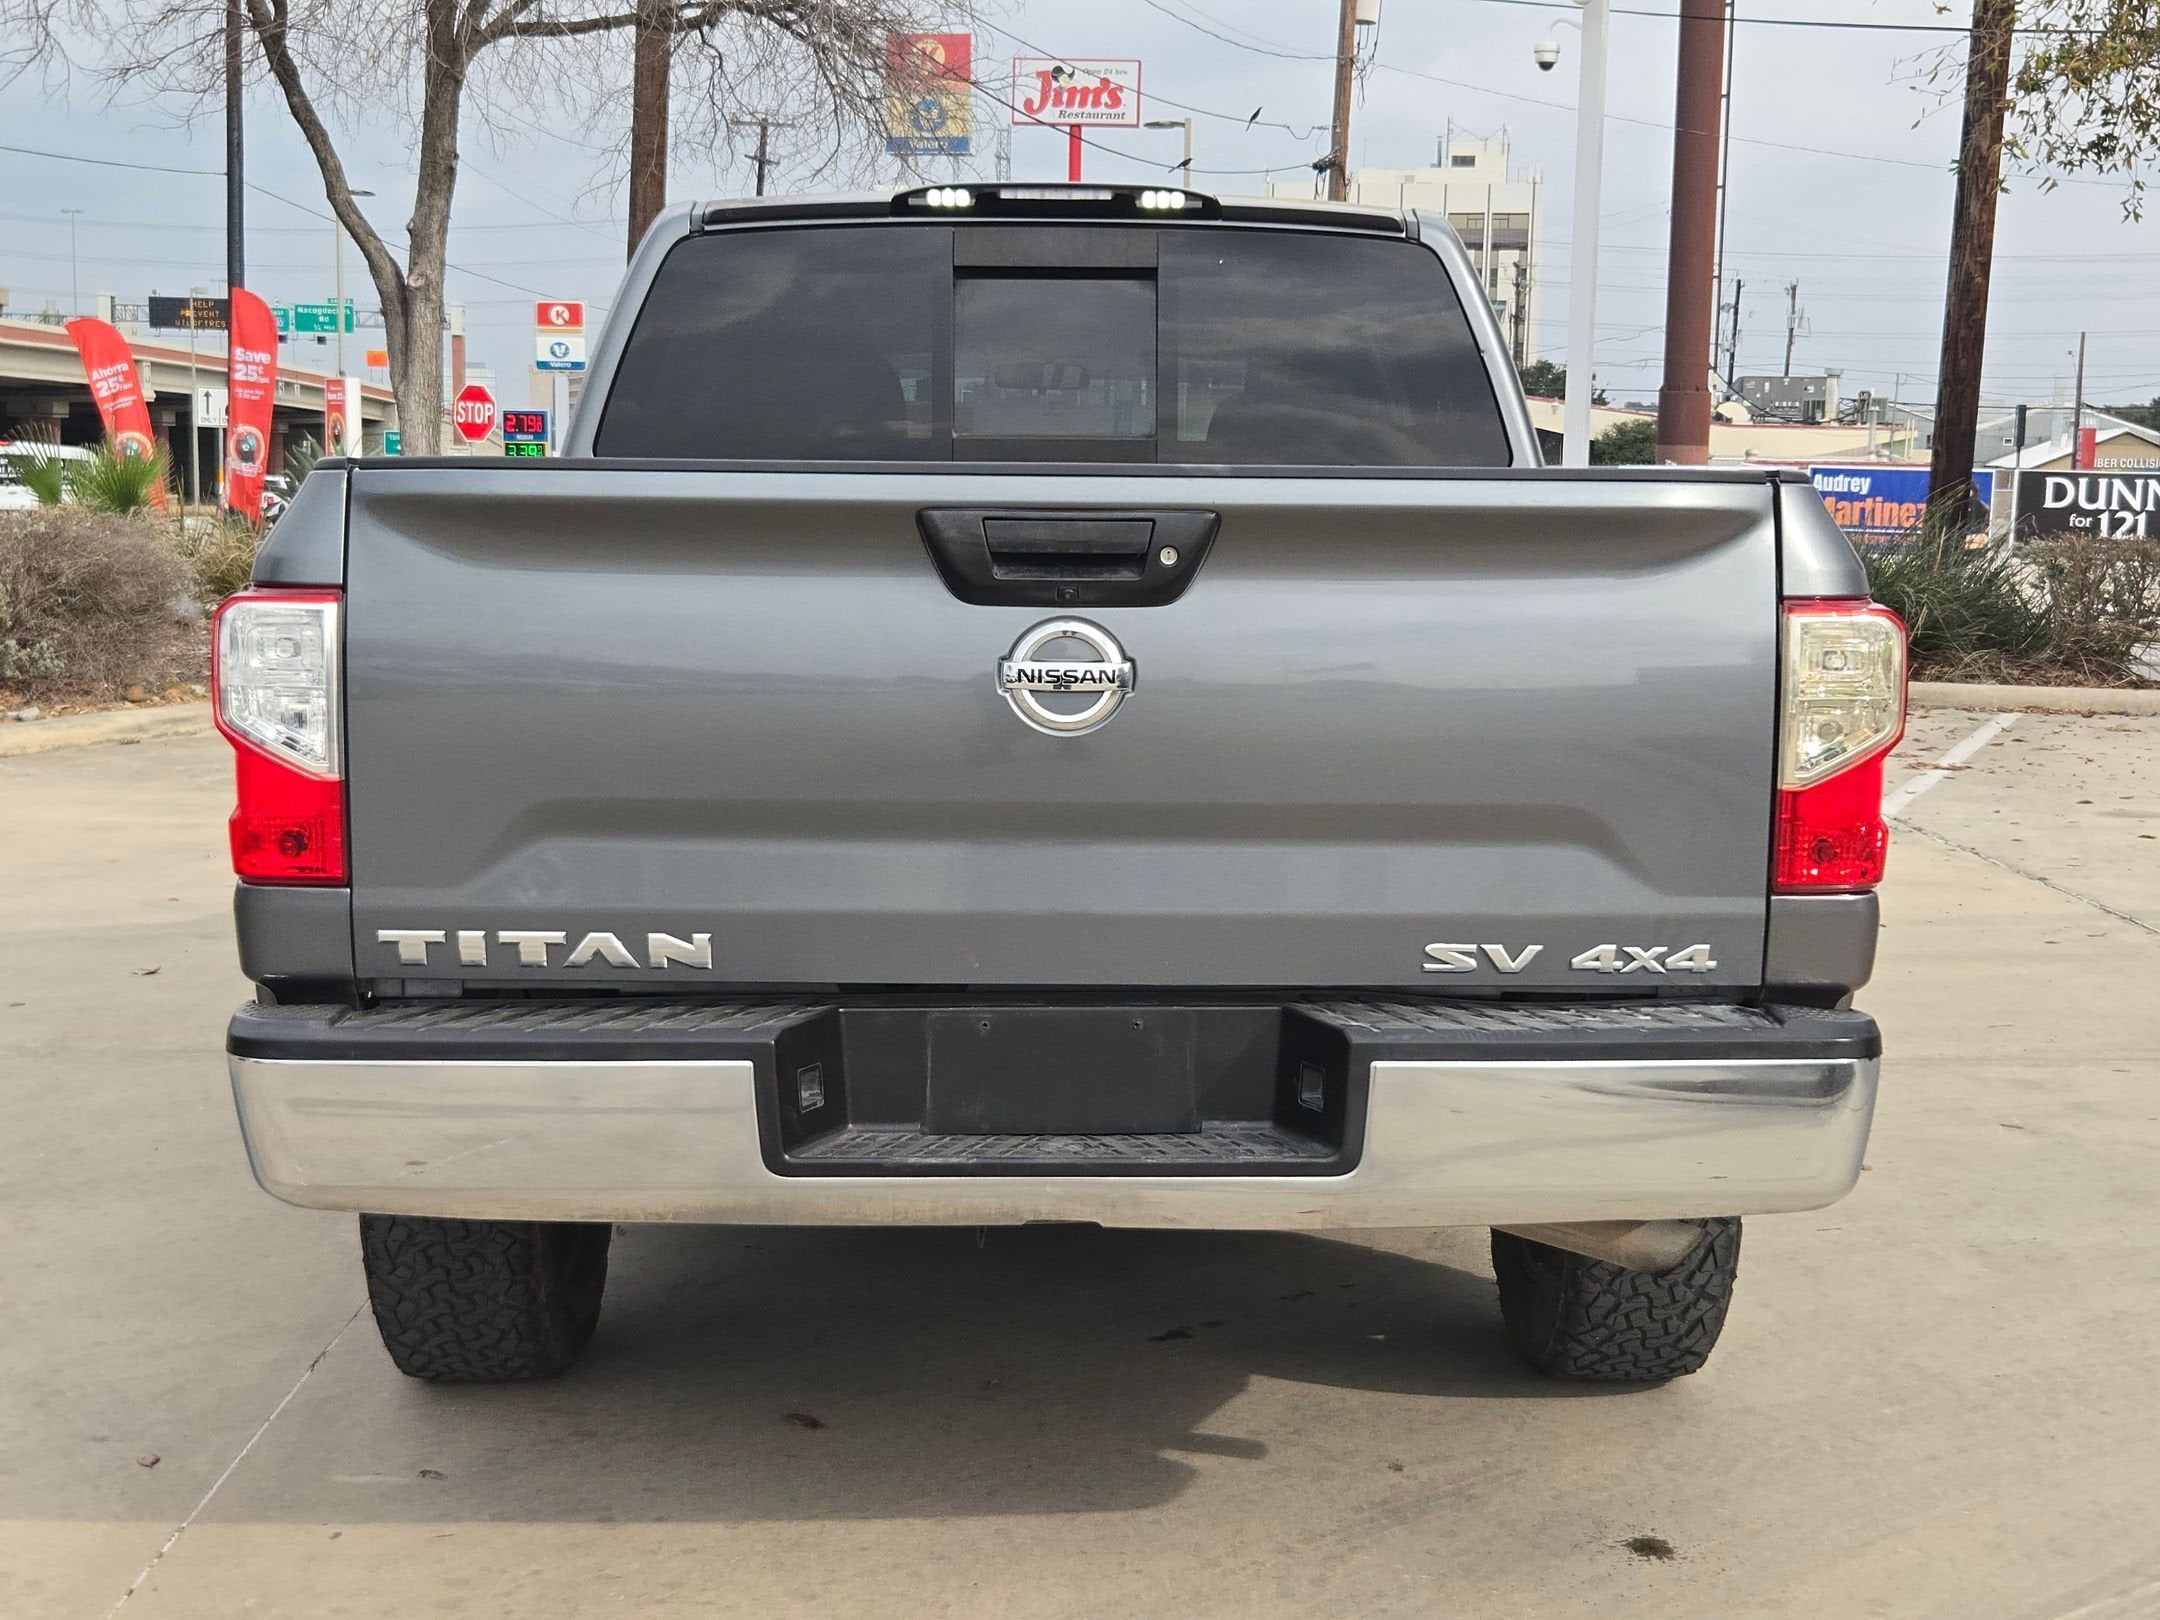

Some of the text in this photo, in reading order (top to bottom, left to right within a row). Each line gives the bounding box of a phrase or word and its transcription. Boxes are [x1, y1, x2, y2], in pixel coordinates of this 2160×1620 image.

[1083, 68, 1101, 76] Open
[1023, 70, 1124, 115] Jim's
[1058, 110, 1126, 120] Restaurant
[192, 300, 215, 308] HELP
[297, 306, 351, 316] Nacogdocs
[235, 347, 271, 364] Save
[92, 363, 129, 381] Ahorra
[457, 402, 494, 424] STOP
[2120, 457, 2160, 469] COLLISI
[1813, 474, 1871, 495] Audrey
[2069, 510, 2147, 540] for 121
[1016, 668, 1116, 684] NISSAN
[376, 929, 713, 970] TITAN
[1422, 942, 1544, 973] SV
